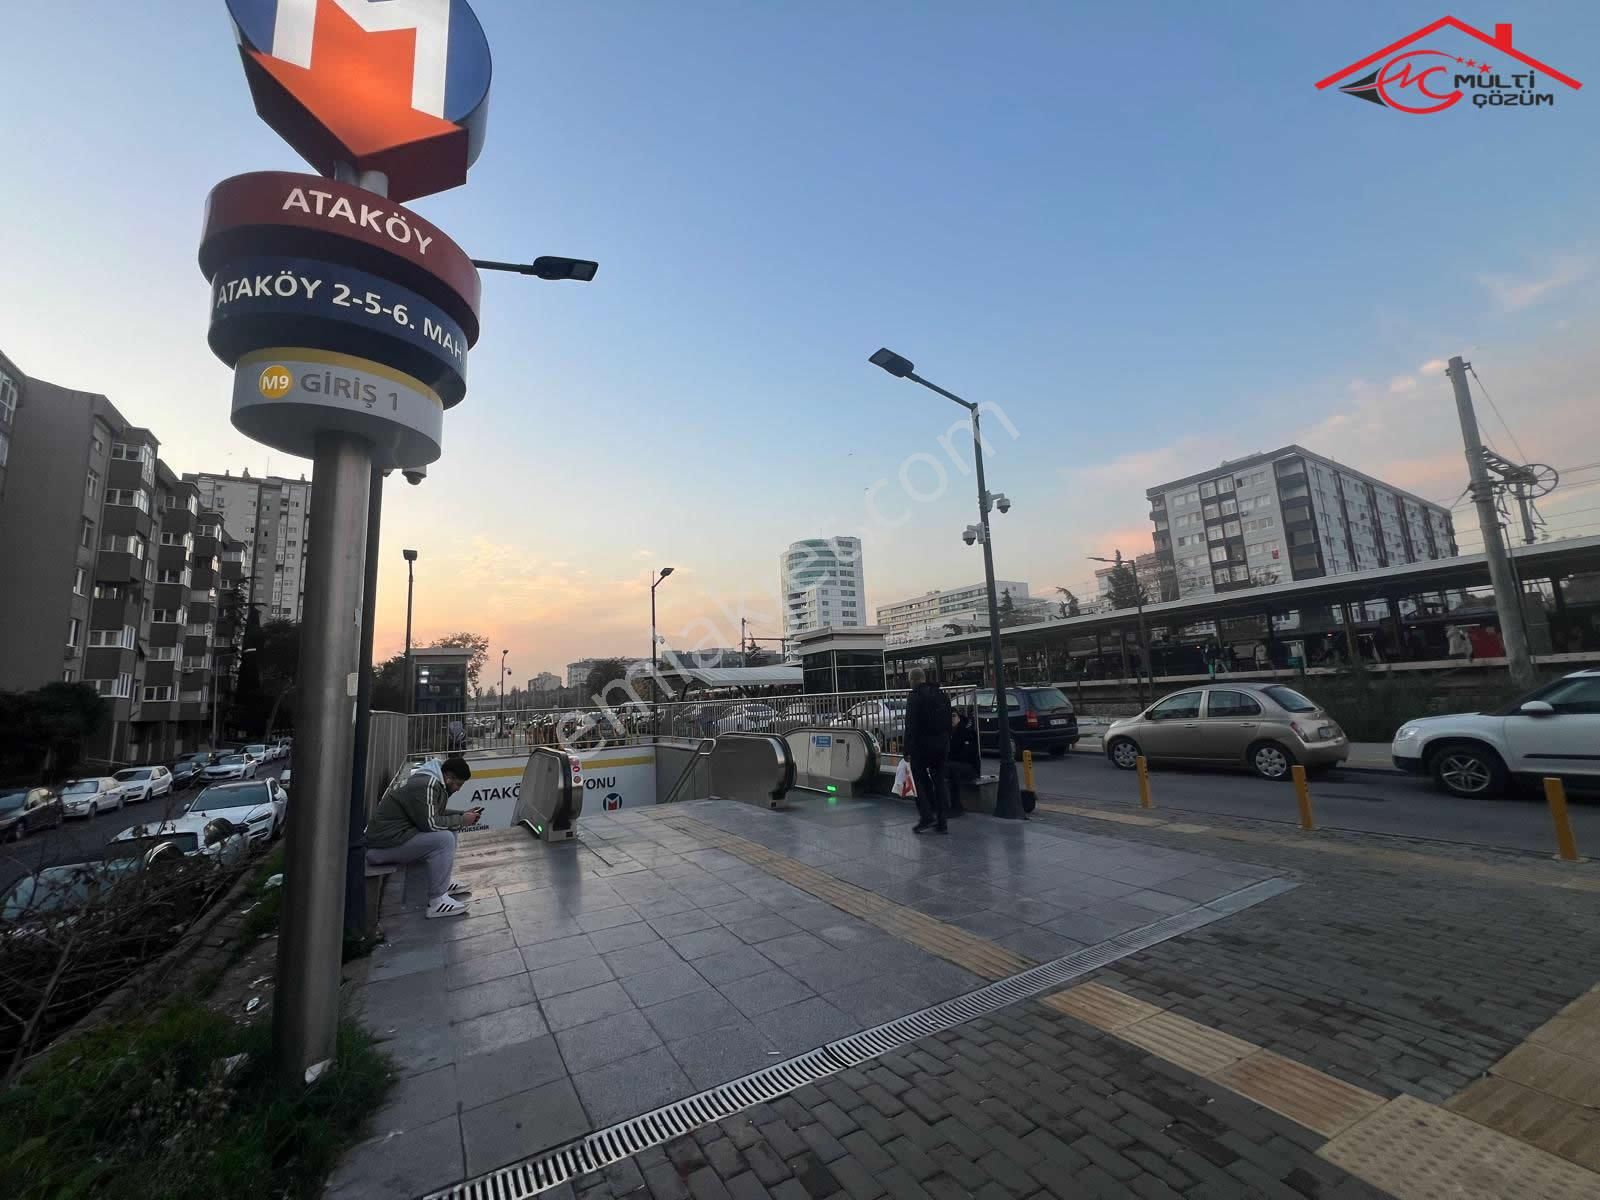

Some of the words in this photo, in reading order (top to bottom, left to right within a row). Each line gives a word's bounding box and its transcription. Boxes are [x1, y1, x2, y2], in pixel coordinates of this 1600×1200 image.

[281, 187, 433, 255] ATAKÖY
[216, 270, 322, 308] ATAKÖY
[332, 283, 416, 330] 2-5-6.
[262, 375, 289, 390] M9
[301, 371, 377, 408] GİRİŞ
[389, 392, 399, 411] 1
